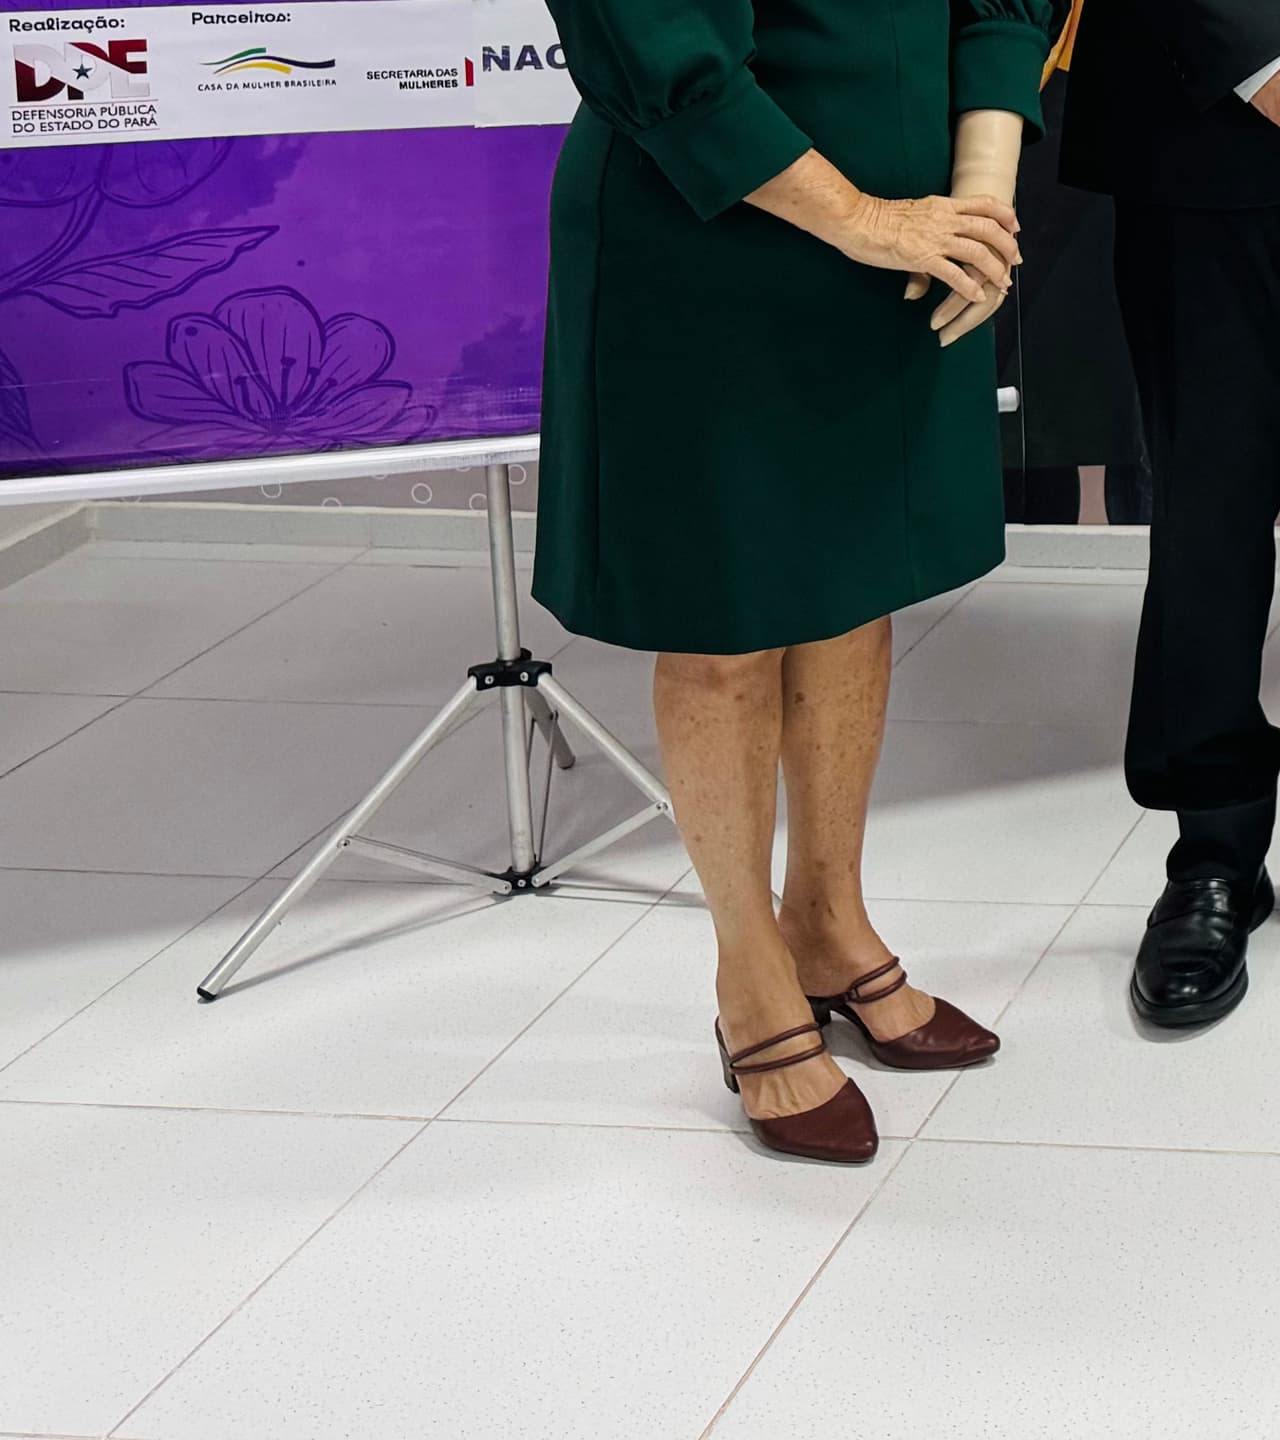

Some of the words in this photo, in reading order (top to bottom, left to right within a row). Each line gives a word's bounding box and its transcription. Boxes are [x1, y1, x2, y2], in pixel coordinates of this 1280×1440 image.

[9, 16, 125, 33] Realização:
[191, 11, 291, 25] Parceiros:
[366, 69, 434, 80] SECRETARIA
[436, 68, 458, 77] DAS
[198, 83, 223, 91] CASA
[226, 82, 240, 90] DA
[243, 81, 281, 89] MULHER
[284, 79, 337, 88] BRASILEIRA
[399, 79, 458, 90] MULHERES
[12, 108, 97, 121] DEFENSORIA
[100, 104, 157, 117] PÚBLICA
[13, 123, 35, 133] DO
[40, 120, 93, 132] ESTADO
[98, 119, 120, 129] DO
[124, 114, 157, 127] PARÁ
